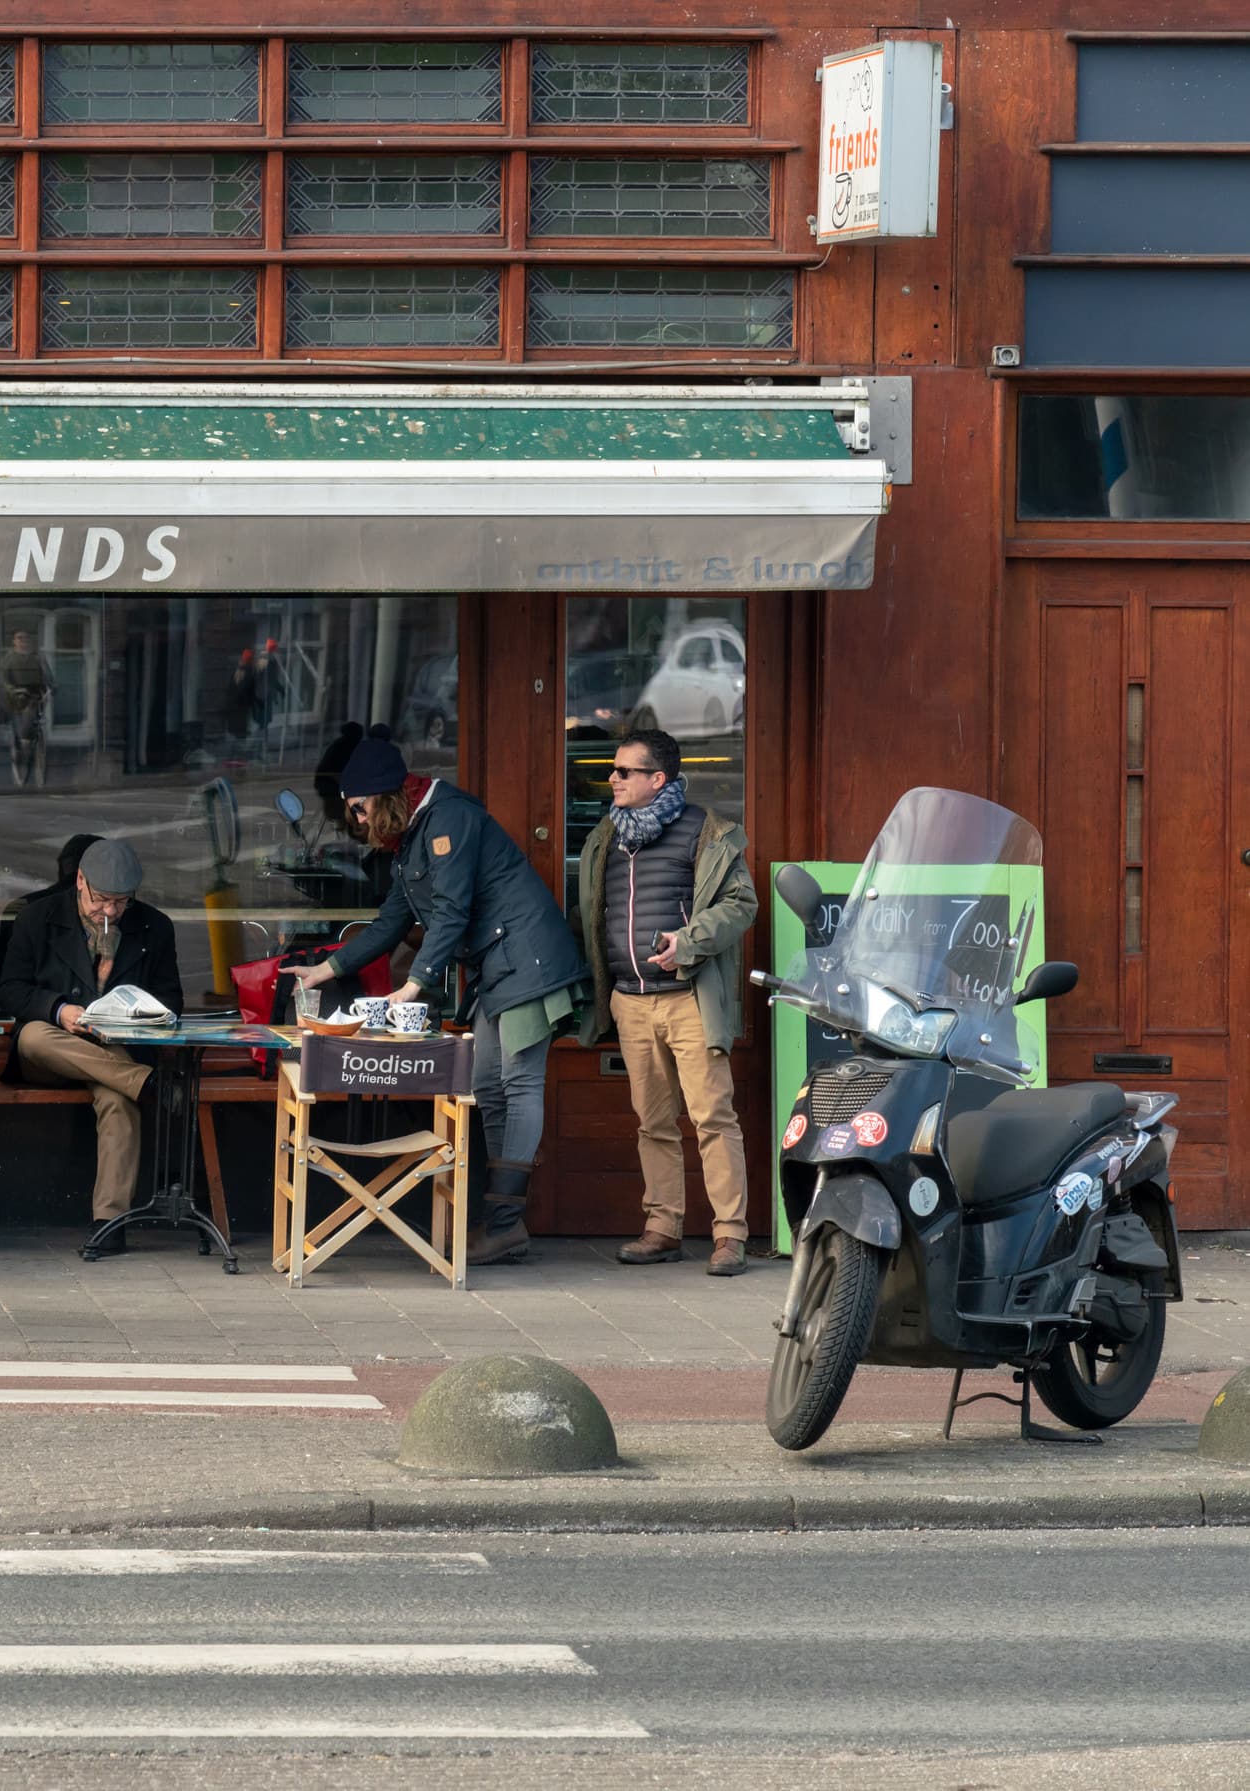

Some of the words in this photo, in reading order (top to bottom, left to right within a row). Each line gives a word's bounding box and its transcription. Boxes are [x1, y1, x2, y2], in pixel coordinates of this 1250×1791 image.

[829, 115, 878, 175] friends
[702, 557, 734, 581] &
[753, 555, 865, 582] lunch
[872, 904, 915, 933] daily
[948, 900, 1000, 950] 7.00
[342, 1051, 435, 1074] foodism
[342, 1072, 356, 1084] by
[359, 1073, 398, 1085] friends
